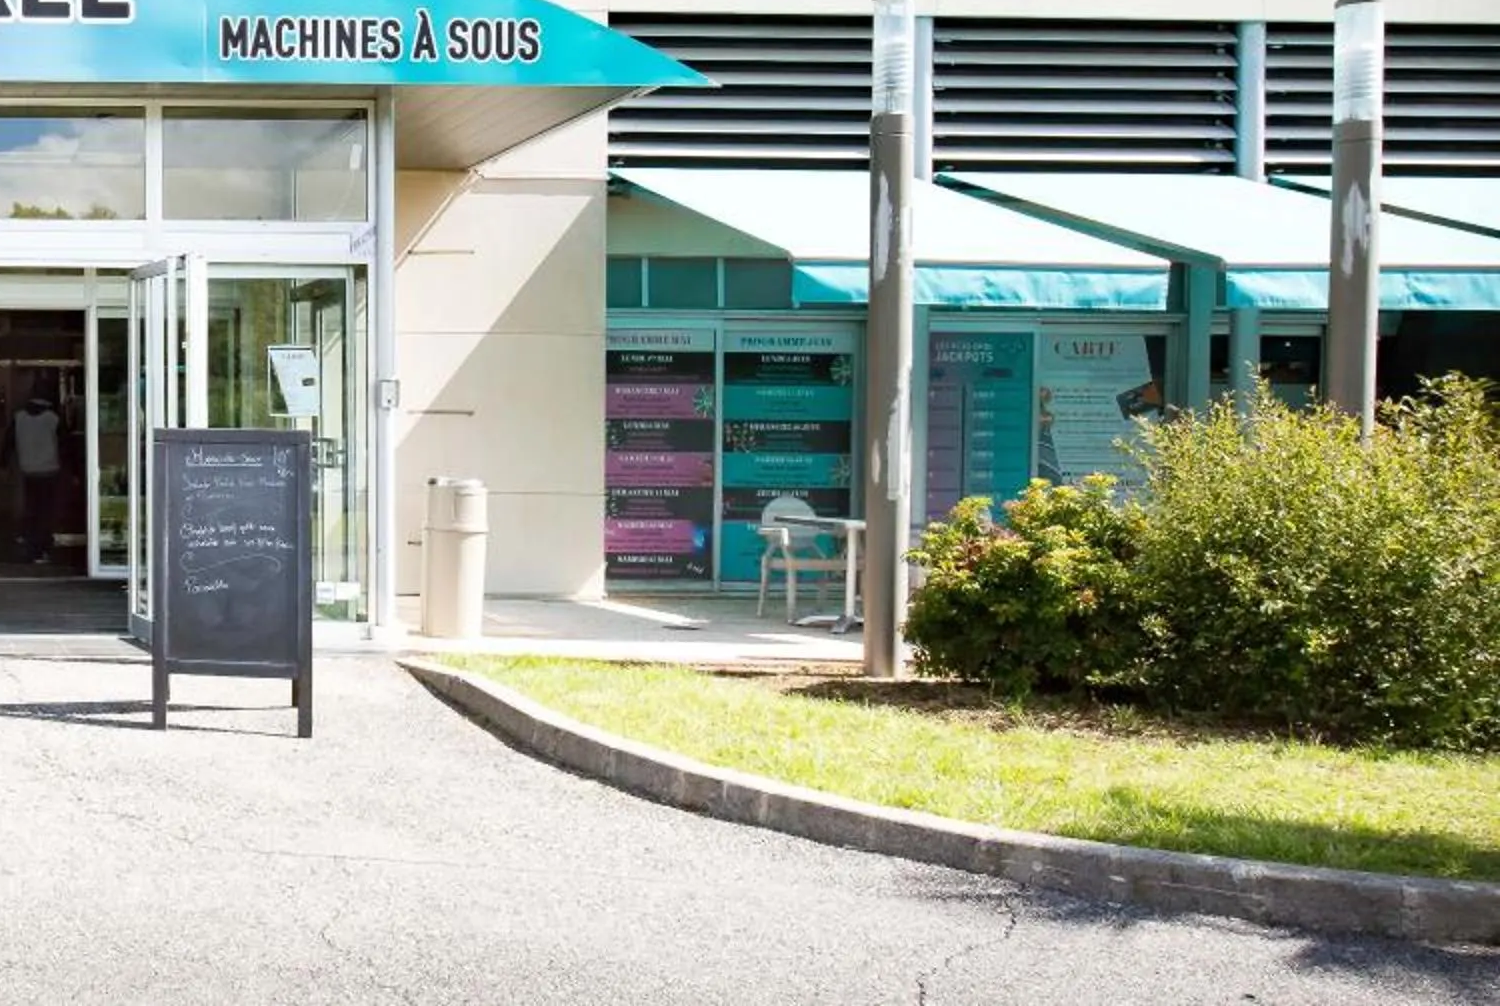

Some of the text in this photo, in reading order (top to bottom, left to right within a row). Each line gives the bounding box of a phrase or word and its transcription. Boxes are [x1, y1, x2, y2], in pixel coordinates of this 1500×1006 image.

[222, 10, 540, 61] MACHINES À SOUS
[935, 351, 994, 363] JACKPOTS
